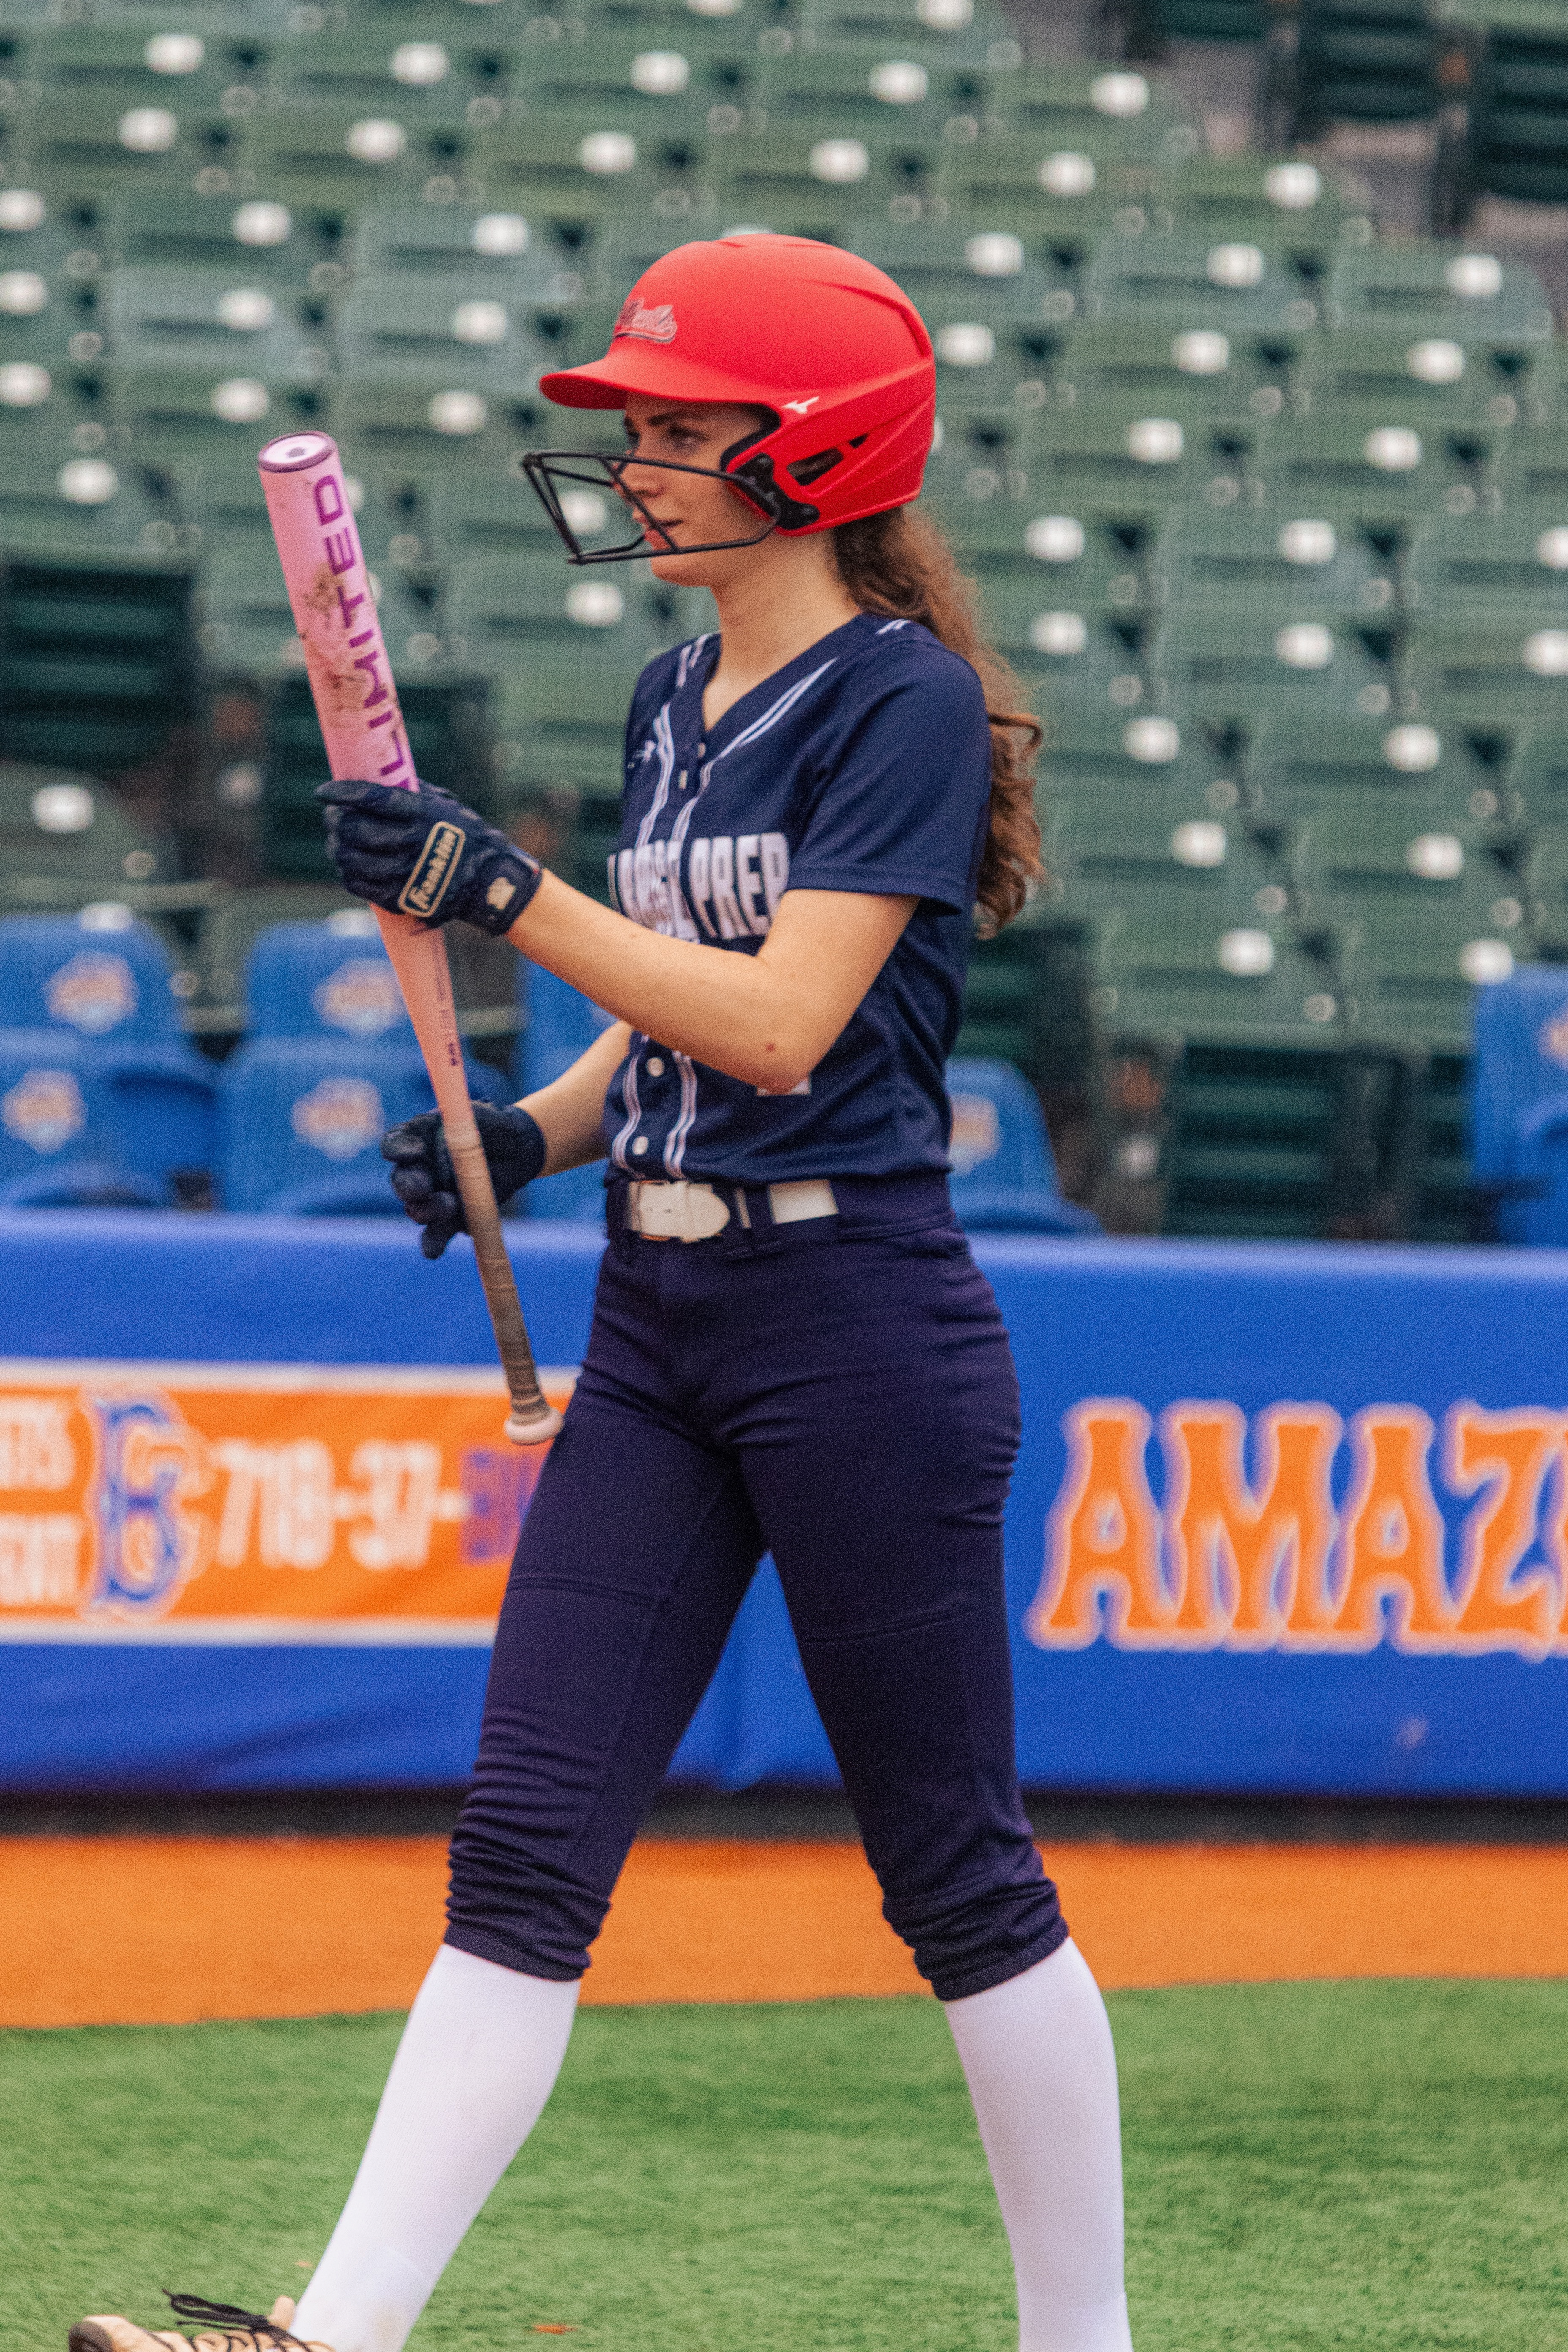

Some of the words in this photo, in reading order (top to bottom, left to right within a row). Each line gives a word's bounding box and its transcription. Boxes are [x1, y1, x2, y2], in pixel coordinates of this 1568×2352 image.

[313, 474, 409, 790] LIMITED
[408, 830, 456, 910] Franklin
[689, 831, 789, 940] PREP
[1023, 1396, 1568, 1660] AMAZ
